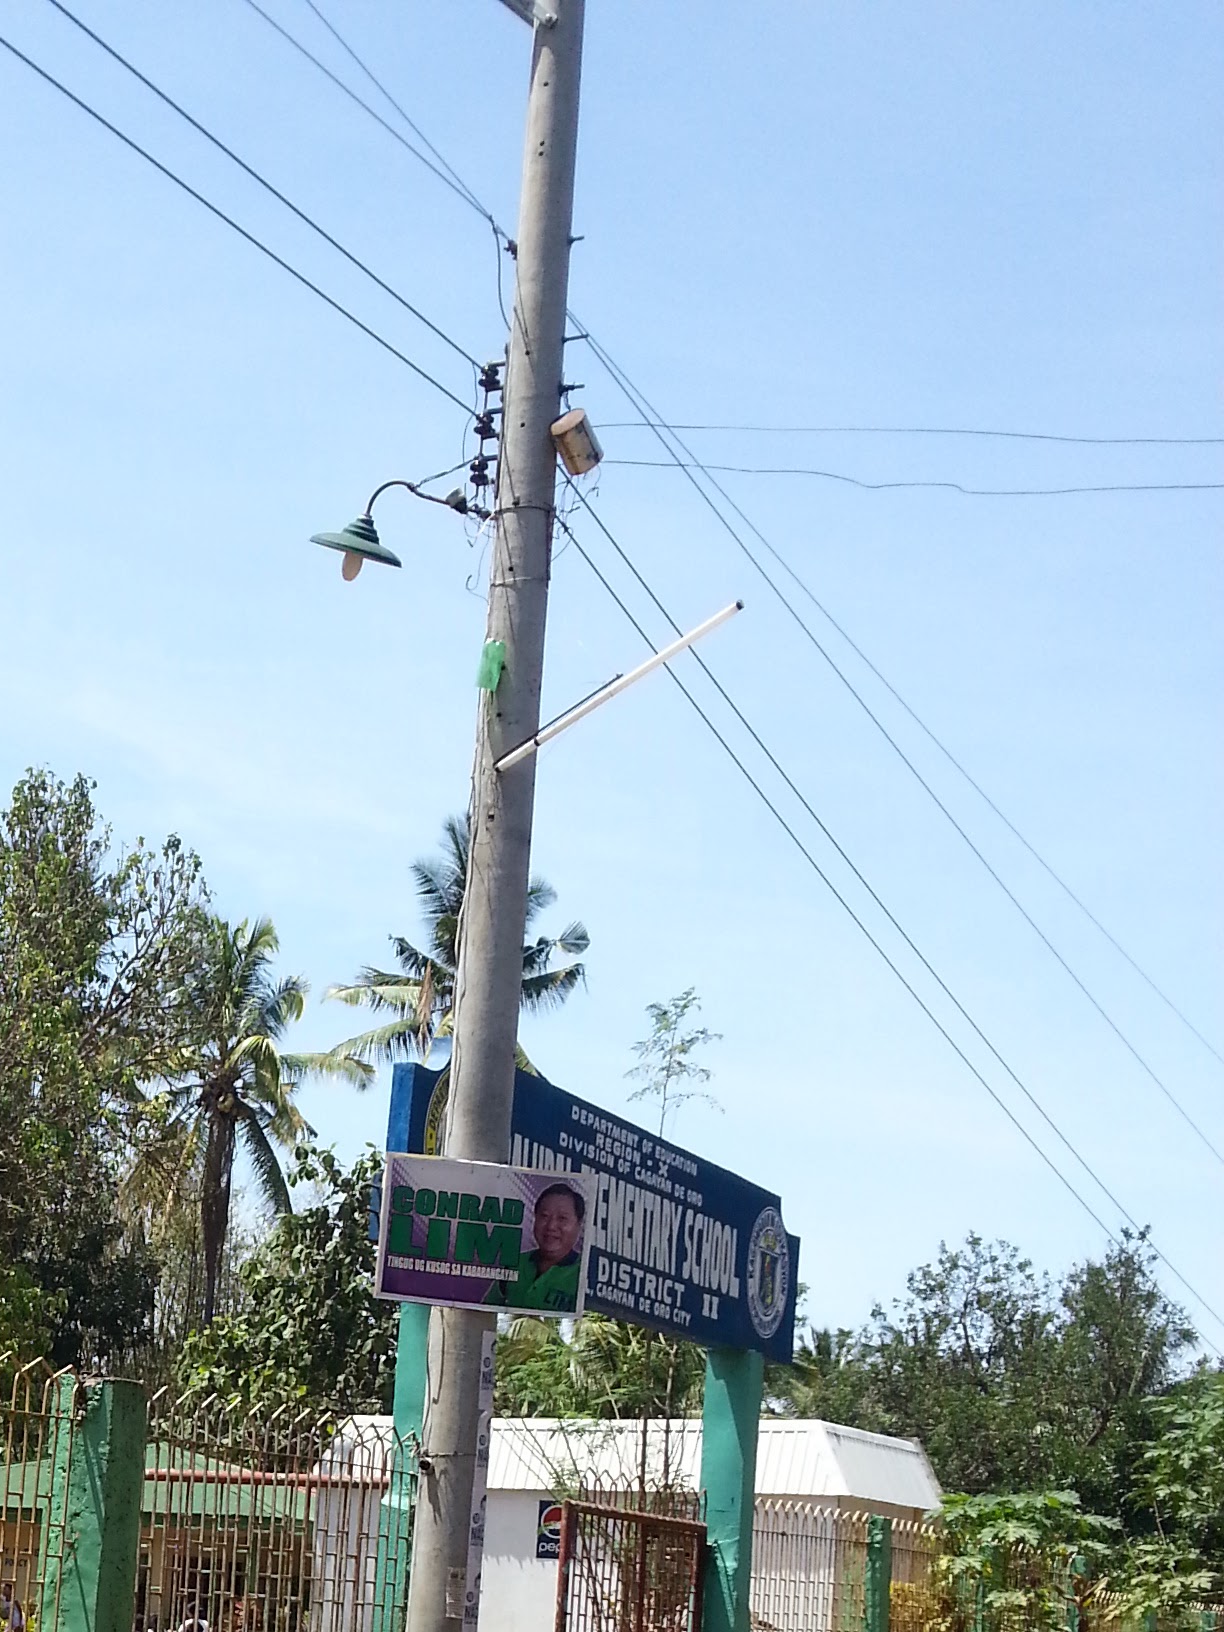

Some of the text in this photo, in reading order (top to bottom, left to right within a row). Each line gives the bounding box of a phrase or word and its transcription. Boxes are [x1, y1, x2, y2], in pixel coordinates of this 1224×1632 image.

[571, 1104, 698, 1177] DEPARTMENT OF EDUCATION
[596, 1132, 641, 1165] REGION
[659, 1161, 669, 1178] X
[559, 1131, 615, 1169] DIVISION
[617, 1158, 631, 1175] OF
[634, 1166, 672, 1193] CAGAYAN
[674, 1183, 685, 1200] DE
[687, 1188, 703, 1207] ORO
[392, 1185, 525, 1226] CONRAD
[581, 1164, 683, 1276] EMENTARY
[682, 1208, 740, 1300] SCHOOL
[389, 1214, 523, 1268] LIM
[451, 1264, 461, 1277] SA
[598, 1255, 719, 1320] DISTRICT II
[596, 1282, 635, 1309] CAGAYAN
[639, 1296, 652, 1314] DE
[653, 1301, 671, 1320] ORO
[673, 1307, 692, 1328] CITY
